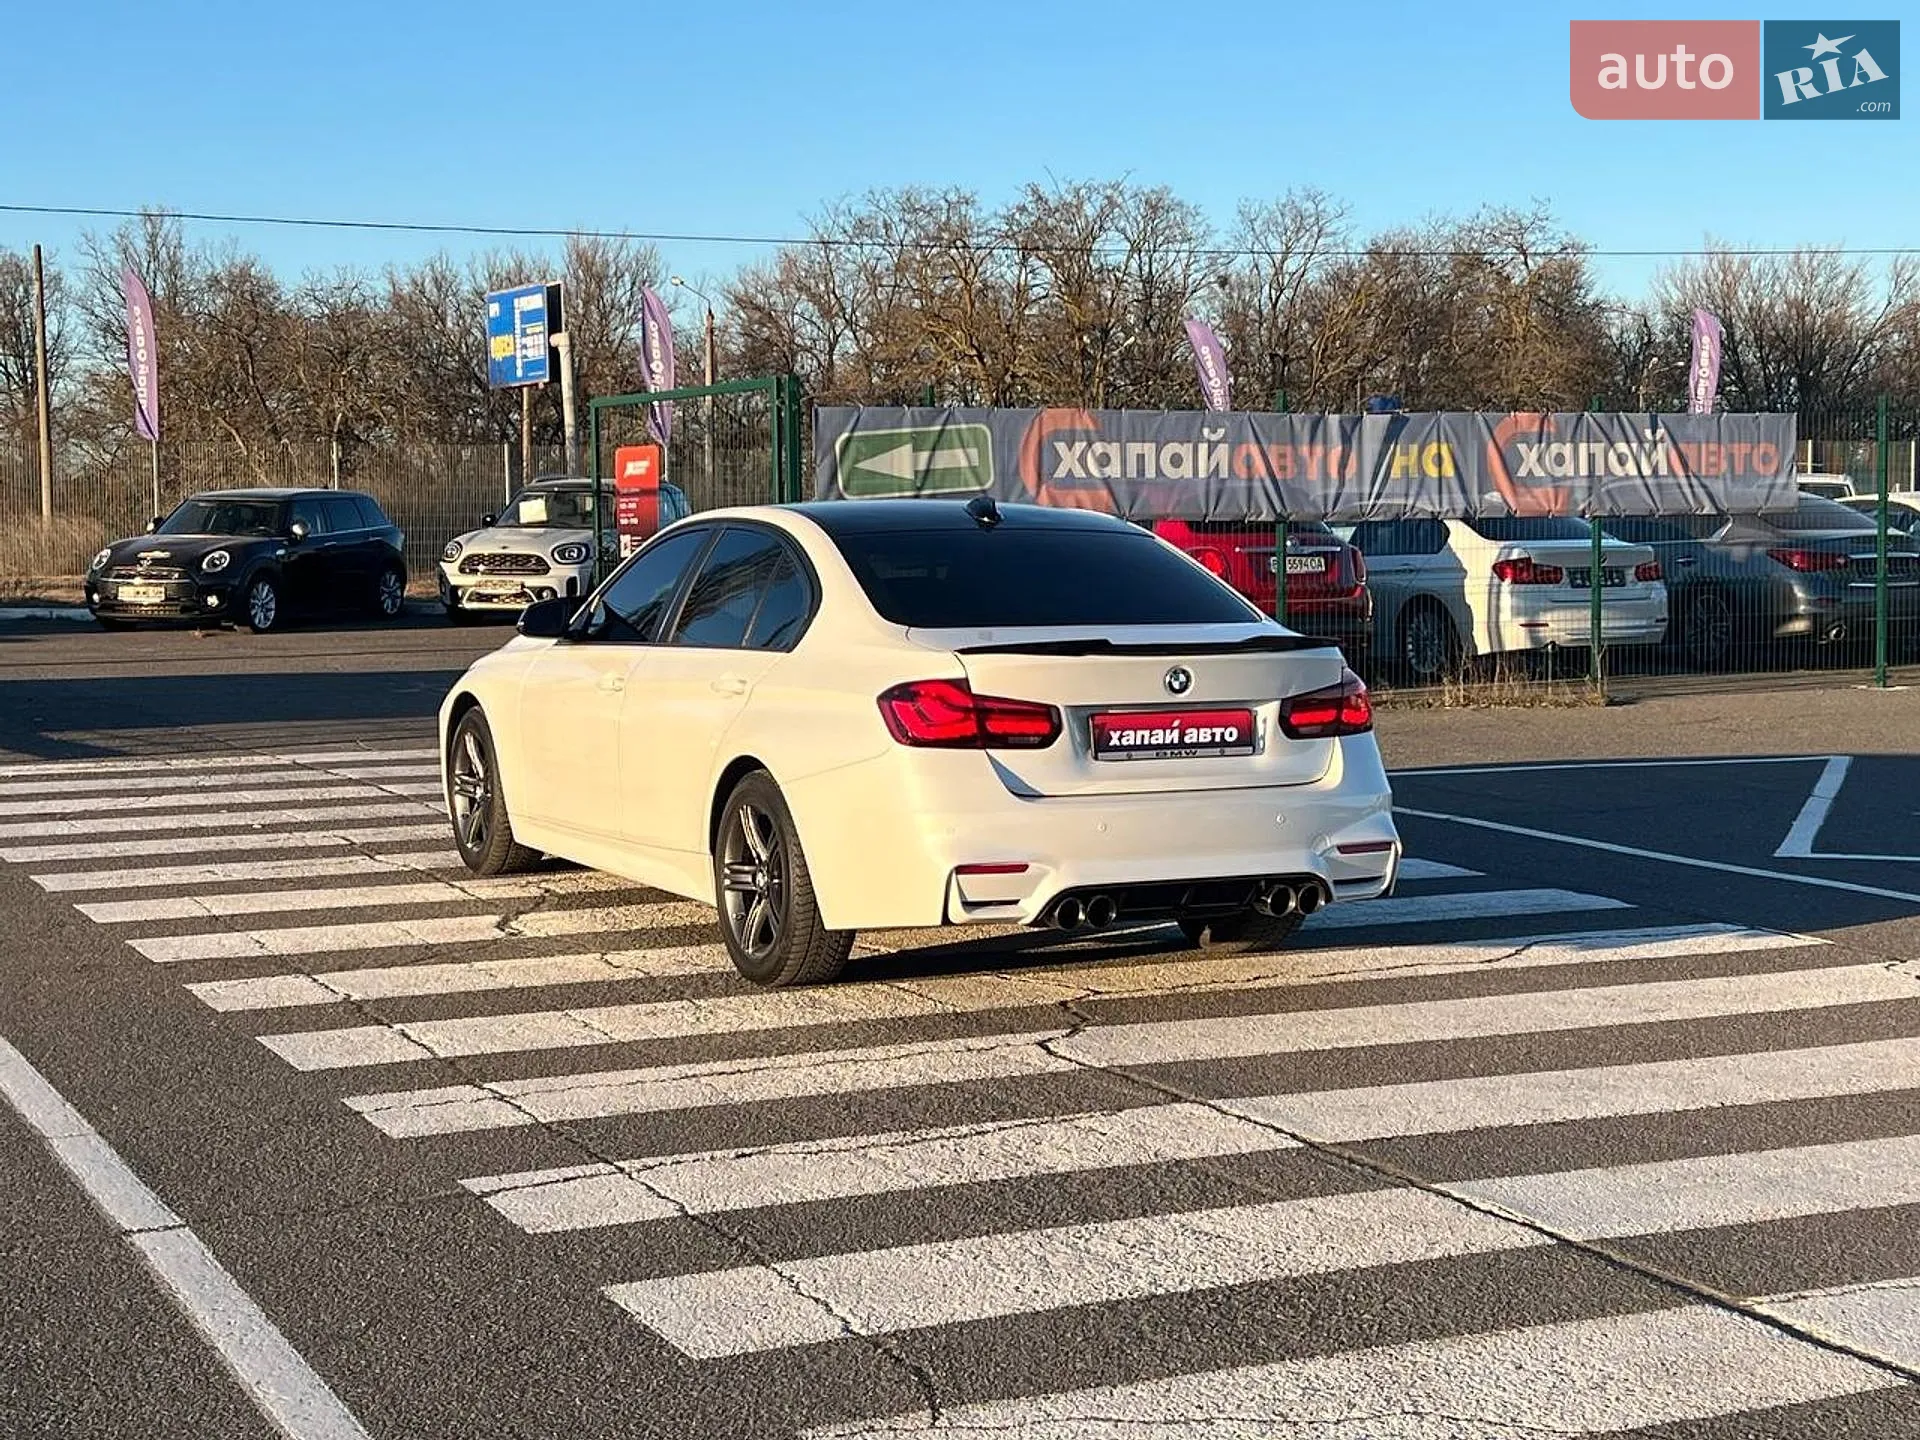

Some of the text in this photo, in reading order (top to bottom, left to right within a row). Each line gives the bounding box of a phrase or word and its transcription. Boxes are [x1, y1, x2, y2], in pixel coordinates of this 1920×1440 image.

[1391, 441, 1456, 479] на
[1109, 719, 1238, 746] хапай авто
